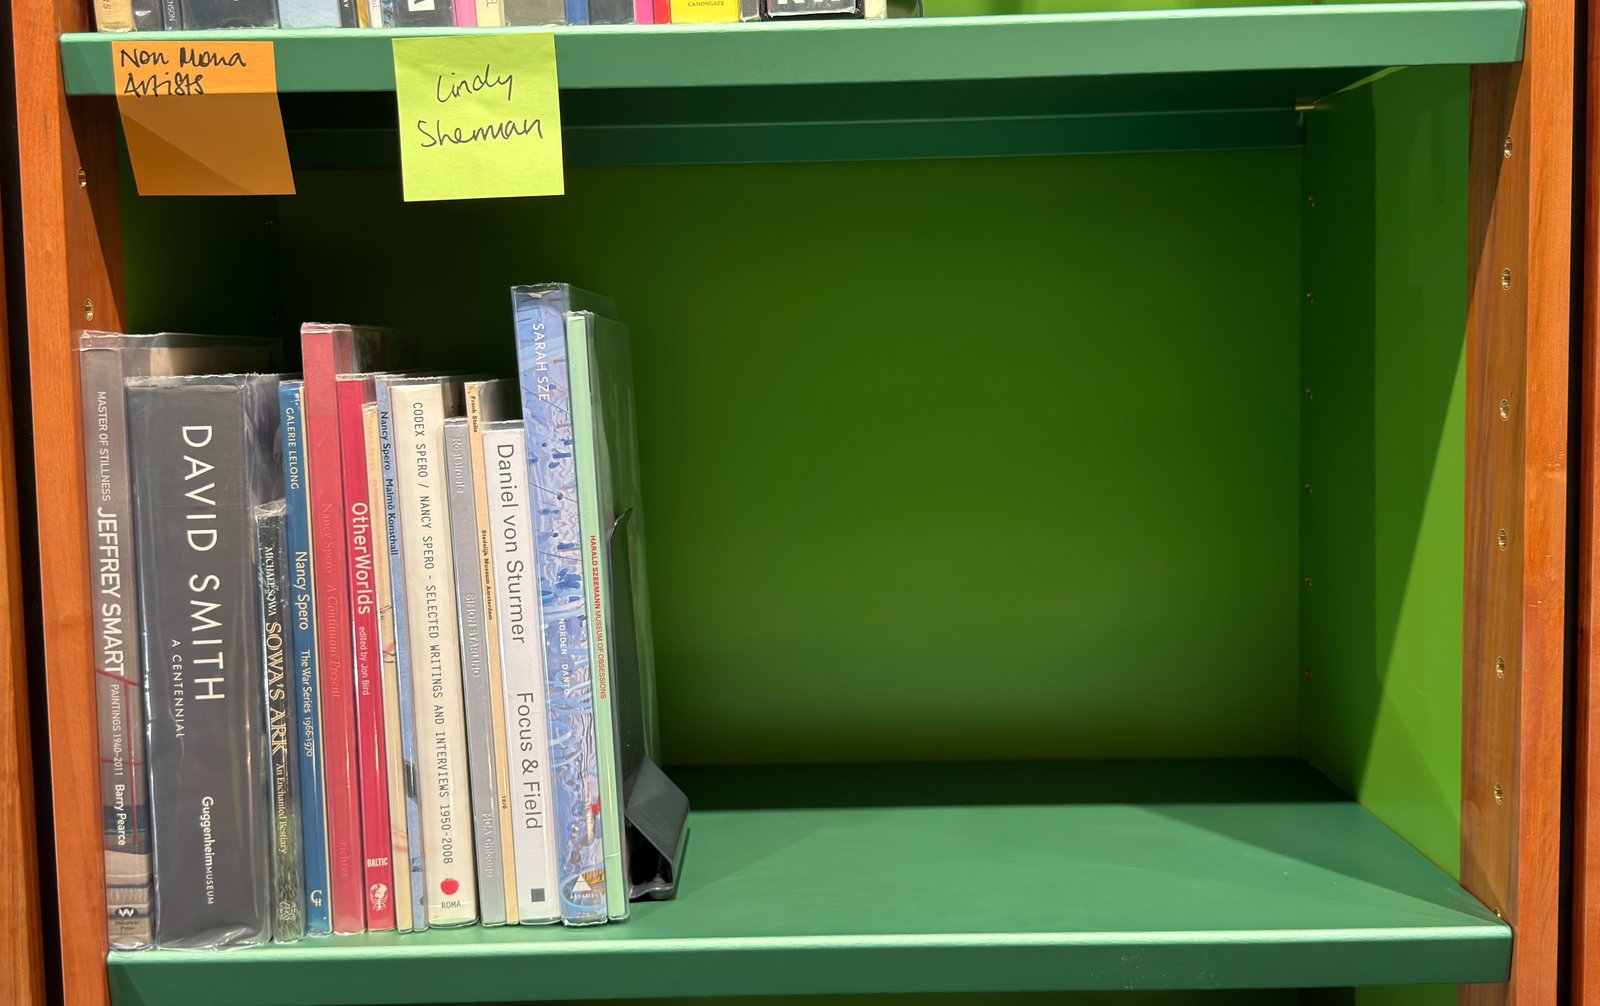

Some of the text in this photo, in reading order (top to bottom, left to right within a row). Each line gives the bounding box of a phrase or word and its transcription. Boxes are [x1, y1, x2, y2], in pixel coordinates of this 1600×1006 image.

[120, 48, 169, 68] Non
[124, 72, 205, 98] Artists
[417, 119, 544, 147] Sherman
[533, 322, 550, 401] SARAH SZE
[97, 391, 108, 432] MASTER
[285, 407, 297, 447] GALERIE
[412, 402, 424, 437] CODEX
[99, 434, 109, 446] OF
[379, 411, 391, 471] Nancy Spero
[415, 443, 428, 478] SPERO
[99, 448, 111, 501] STILLNESS
[287, 449, 300, 490] LELONG
[320, 503, 334, 538] Nancy
[386, 478, 398, 556] Malmö Konsthall
[419, 495, 431, 529] NANCY
[97, 507, 121, 599] JEFFREY
[181, 425, 225, 699] DAVID SMITH
[351, 502, 373, 615] OtherWorlds
[422, 535, 434, 570] SPERO
[498, 444, 525, 644] Daniel von Sturmer
[265, 546, 277, 617] MICHAEL SOWA
[294, 551, 309, 630] Nancy Spero
[483, 558, 491, 585] Museum
[426, 585, 439, 639] SELECTED
[590, 535, 607, 699] HARALD SZEEMANN MUSEUM OF OBSESSIONS
[102, 603, 124, 676] SMART
[558, 618, 568, 656] NORDEN
[330, 660, 342, 698] Present
[359, 626, 371, 695] edited by Jon Bird
[430, 643, 443, 698] WRITINGS
[561, 663, 570, 696] DANTO
[111, 684, 121, 731] PAINTINGS
[172, 639, 186, 738] A CENTENNIAL
[265, 621, 288, 757] SOWA'S ARK
[301, 650, 314, 757] The War Series 1966-1970
[433, 704, 445, 725] AND
[435, 732, 449, 798] INTERVIEWS
[516, 692, 543, 830] Focus & Field
[115, 784, 126, 814] Barry
[276, 774, 286, 820] Enchanted
[116, 814, 127, 846] Pearce
[278, 820, 288, 854] Bestiary
[439, 804, 453, 864] 1950-2008
[366, 858, 389, 868] BALTIC
[441, 899, 462, 910] ROMA
